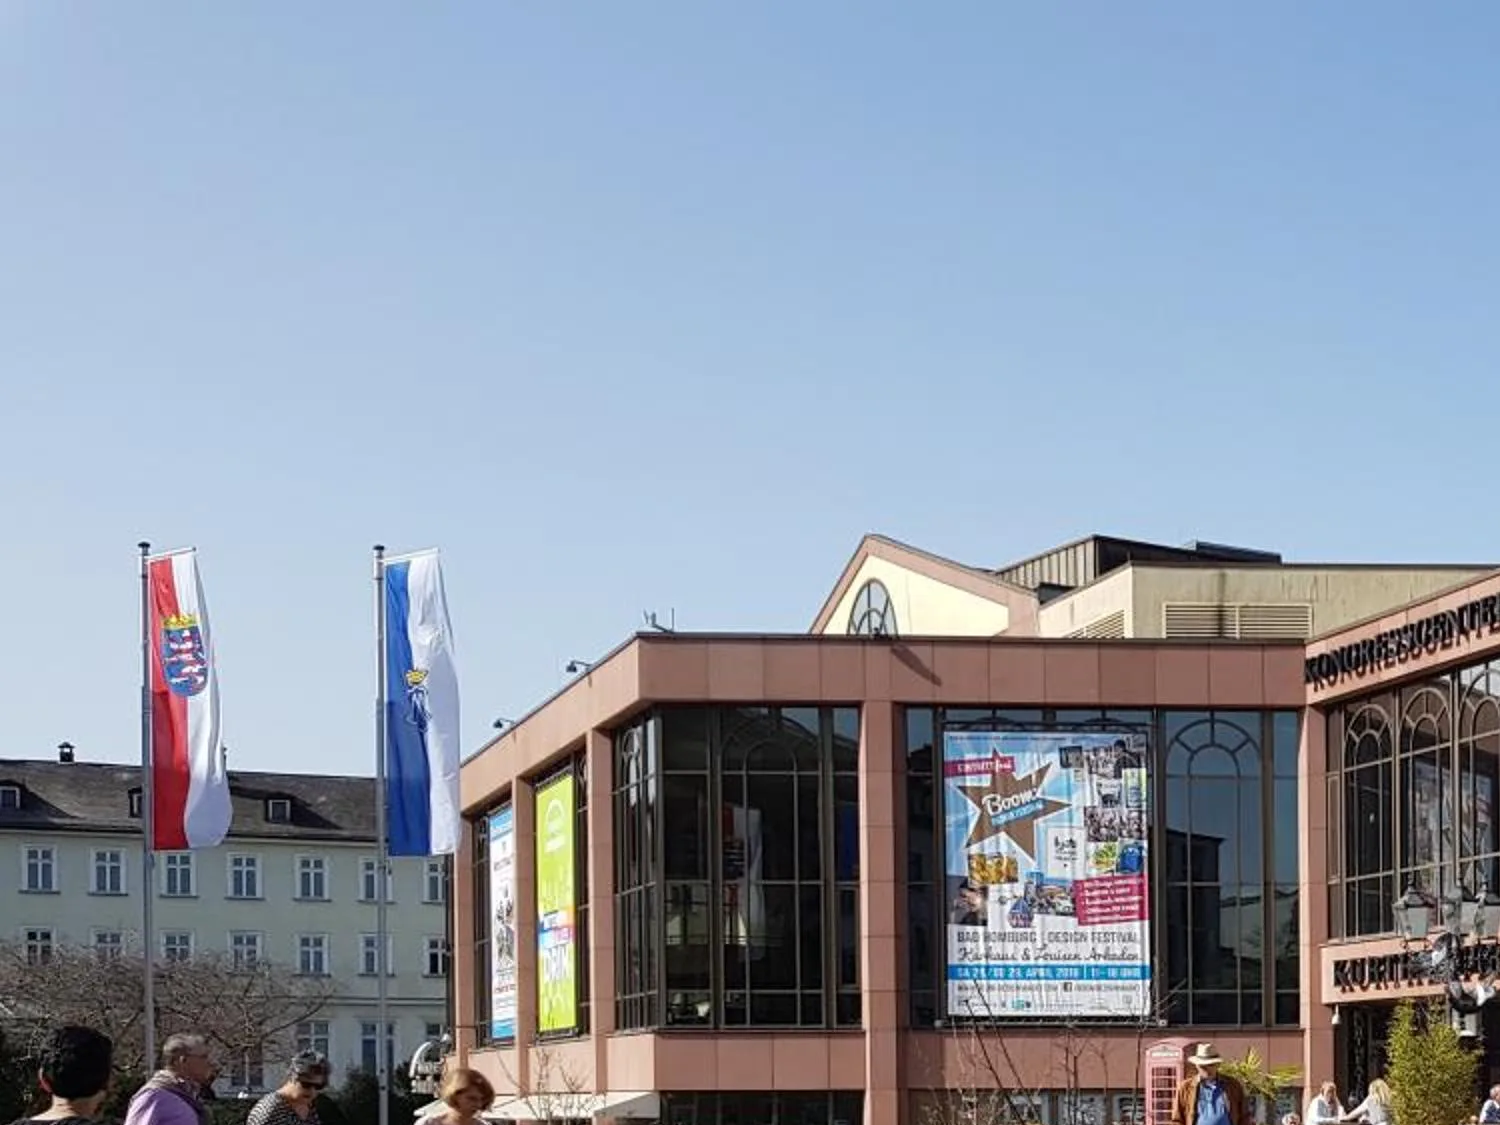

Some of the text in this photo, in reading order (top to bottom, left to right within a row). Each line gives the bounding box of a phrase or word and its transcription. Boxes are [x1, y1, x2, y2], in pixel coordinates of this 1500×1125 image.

[957, 931, 1137, 943] BAD HOMBURG DESIGN FESTIVAL
